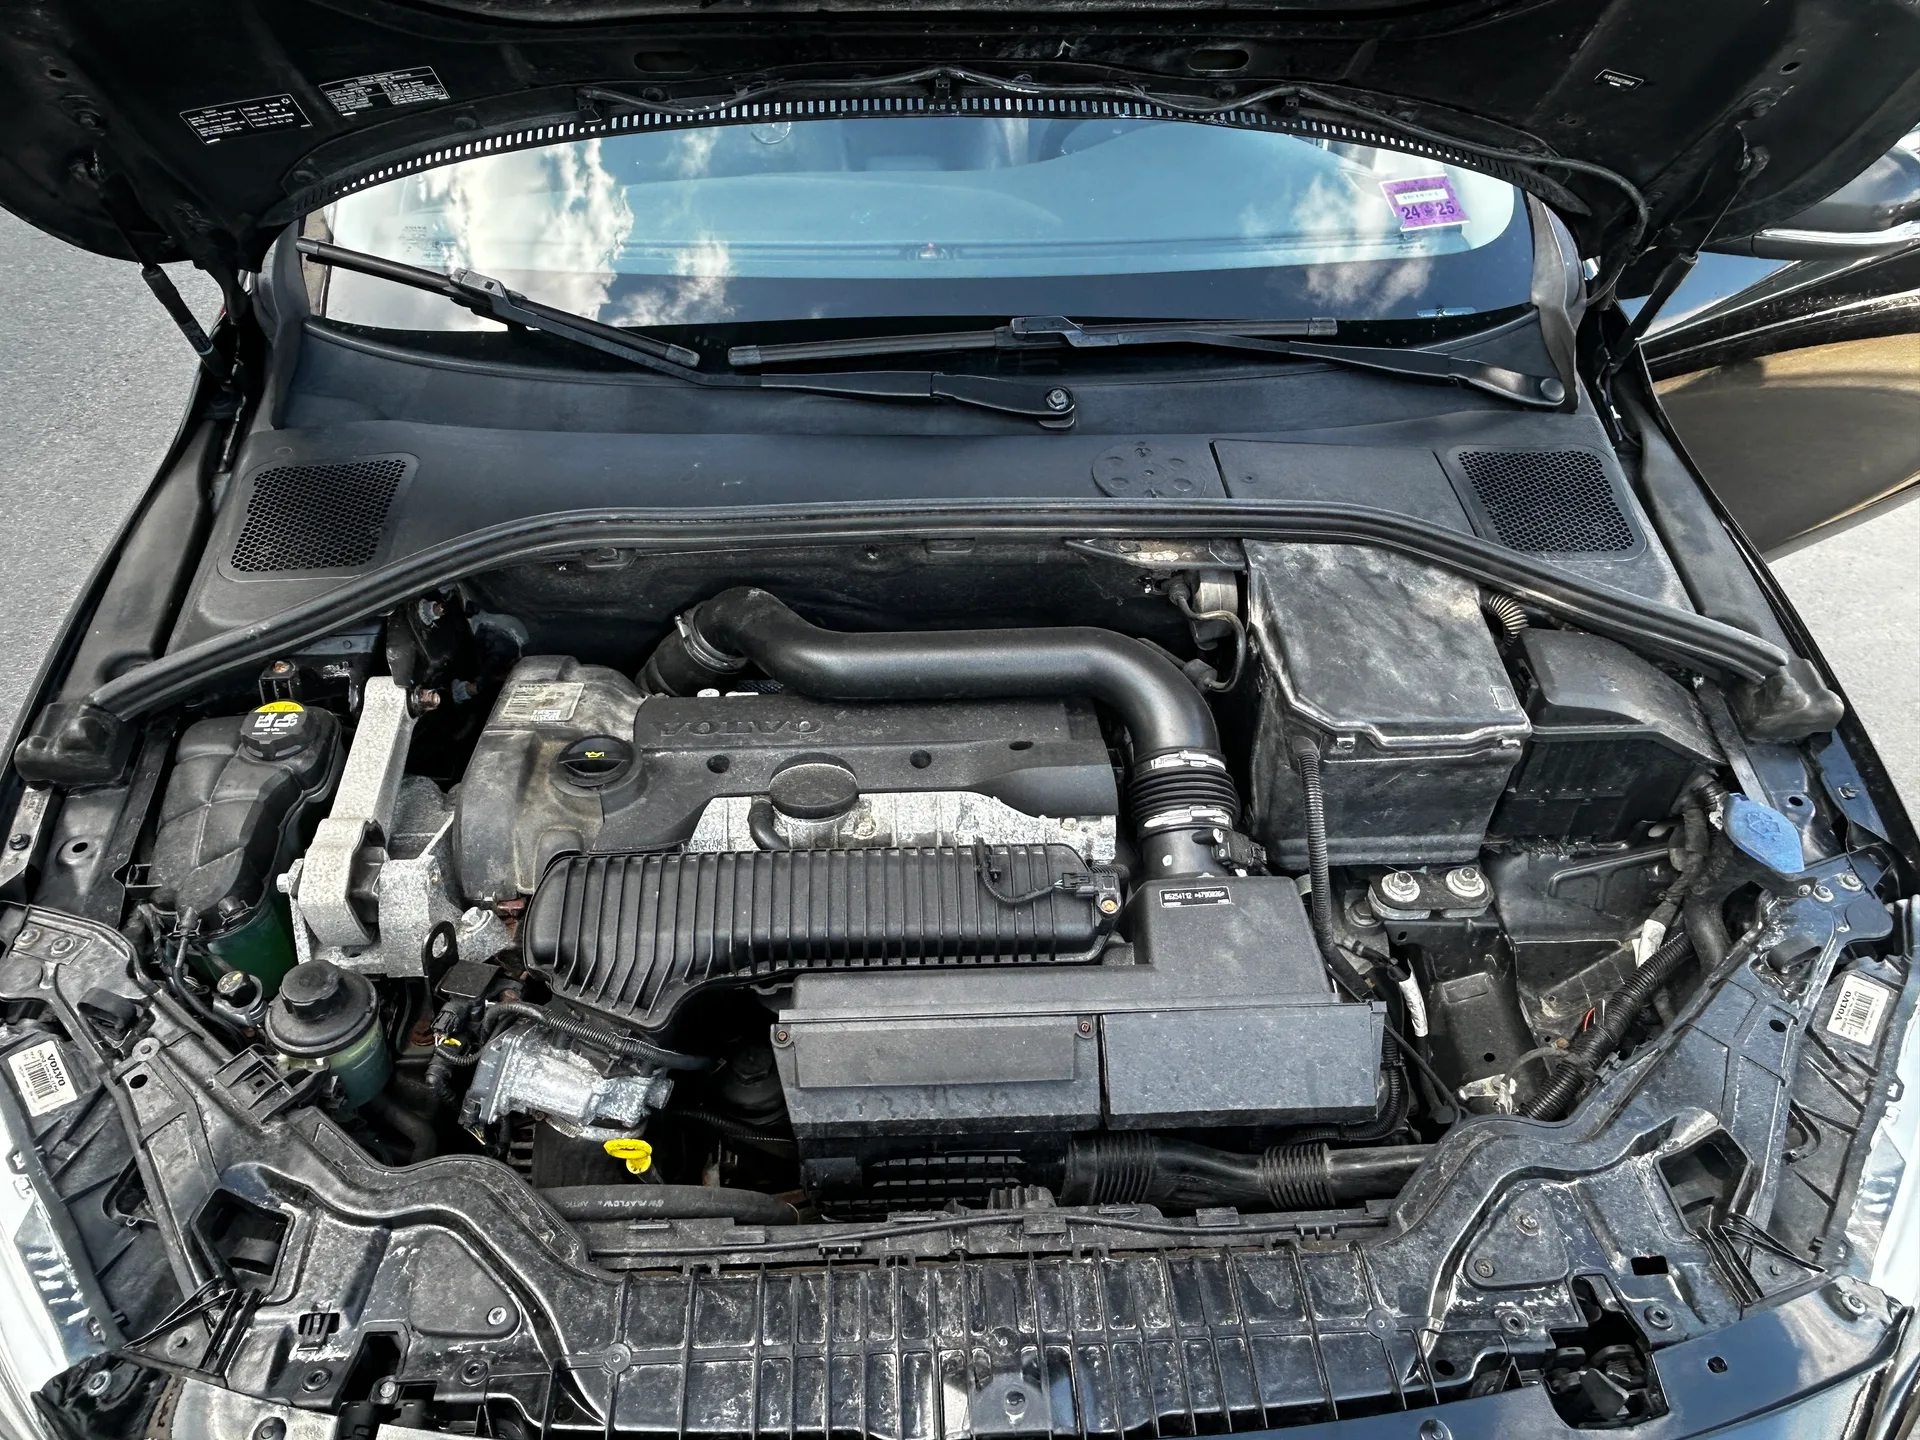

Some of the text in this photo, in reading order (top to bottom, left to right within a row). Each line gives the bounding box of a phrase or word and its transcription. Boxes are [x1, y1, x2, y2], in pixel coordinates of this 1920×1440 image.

[1401, 201, 1455, 220] 24 25
[653, 719, 825, 737] VOLVO
[1834, 990, 1852, 1021] VOLVO
[47, 1053, 66, 1087] VOLVO
